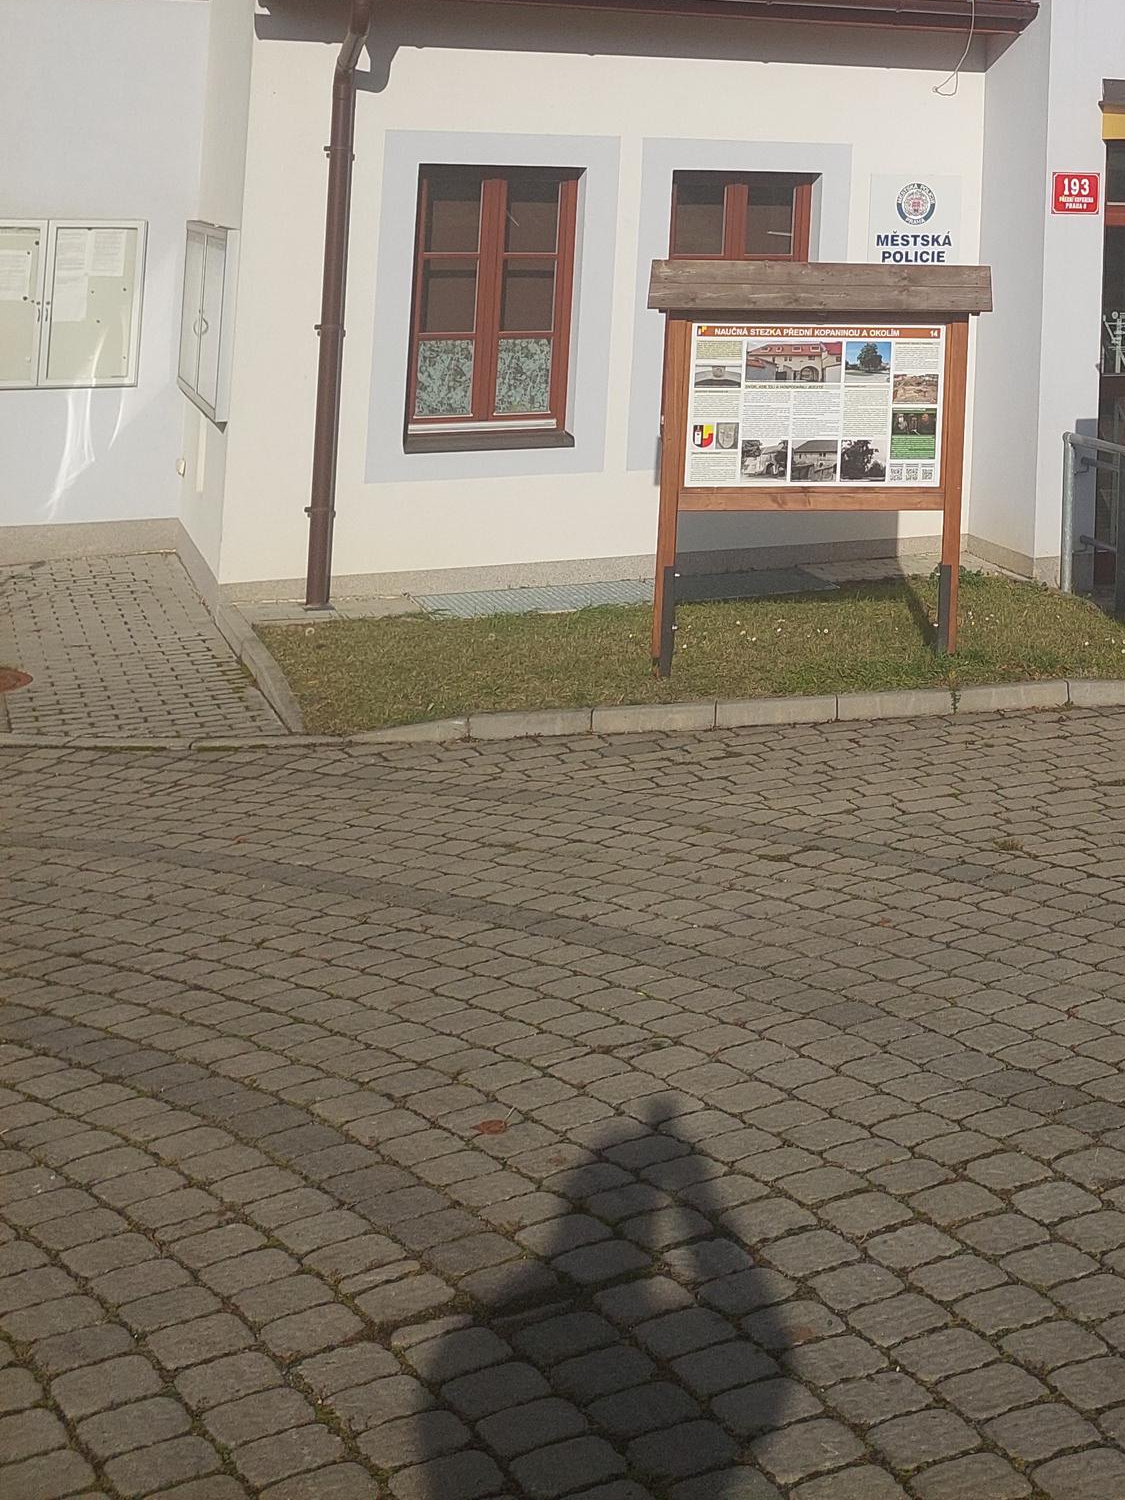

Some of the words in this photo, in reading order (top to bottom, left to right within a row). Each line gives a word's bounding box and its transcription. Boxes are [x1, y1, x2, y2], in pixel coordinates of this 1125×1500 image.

[1064, 178, 1089, 195] 193
[876, 230, 952, 247] MĚSTSKÁ
[881, 250, 946, 264] POLICIE
[714, 327, 748, 336] NAUČNÁ
[750, 328, 782, 336] STEZKA
[783, 328, 813, 337] PŘEDNÍ
[814, 328, 860, 337] KOPANINOU
[861, 329, 868, 337] A
[869, 329, 900, 337] OKOLÍM
[930, 330, 939, 338] 14
